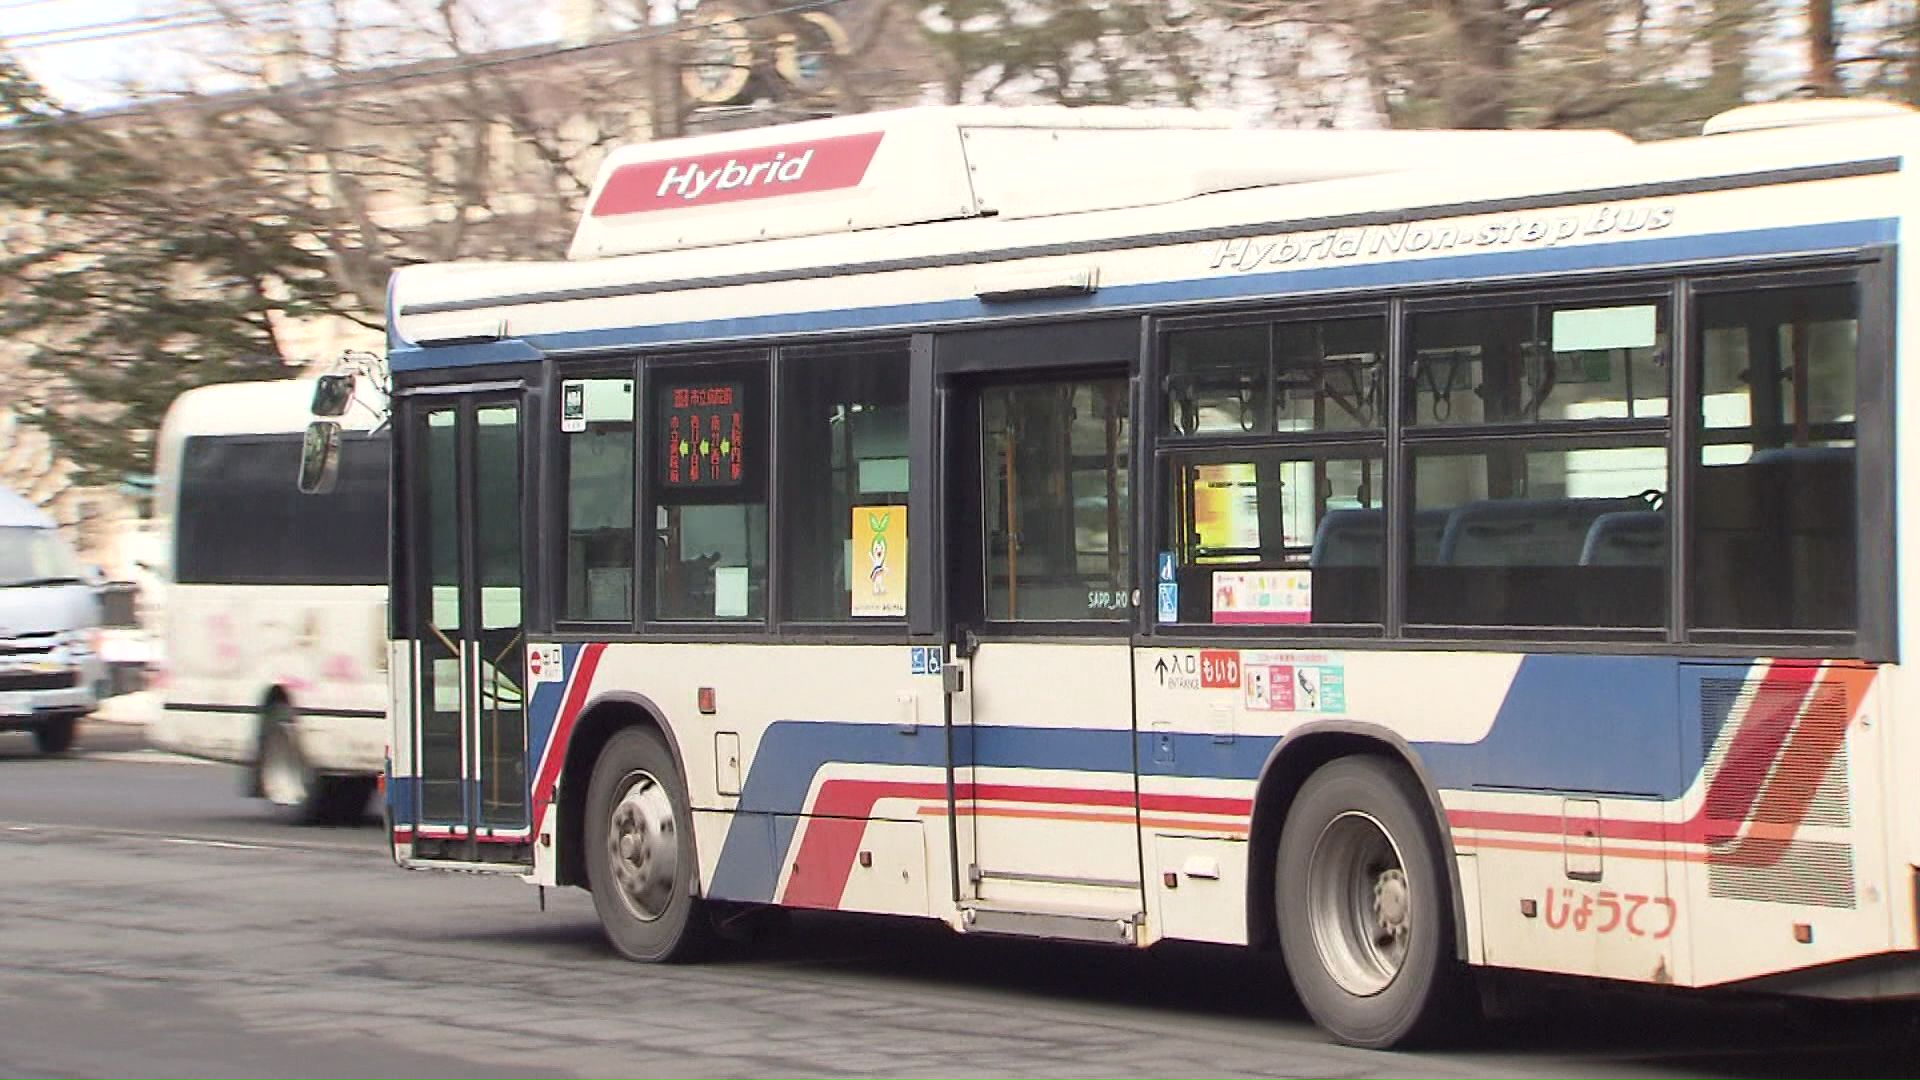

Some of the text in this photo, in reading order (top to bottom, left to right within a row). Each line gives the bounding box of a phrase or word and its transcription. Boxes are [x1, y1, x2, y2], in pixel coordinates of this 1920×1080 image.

[656, 149, 815, 200] Hybrid
[1209, 228, 1367, 272] Hybrid
[1583, 206, 1675, 236] Bus
[1171, 655, 1196, 674] 入口
[1202, 656, 1239, 685] もいわ
[1545, 887, 1677, 939] じょうてつ
